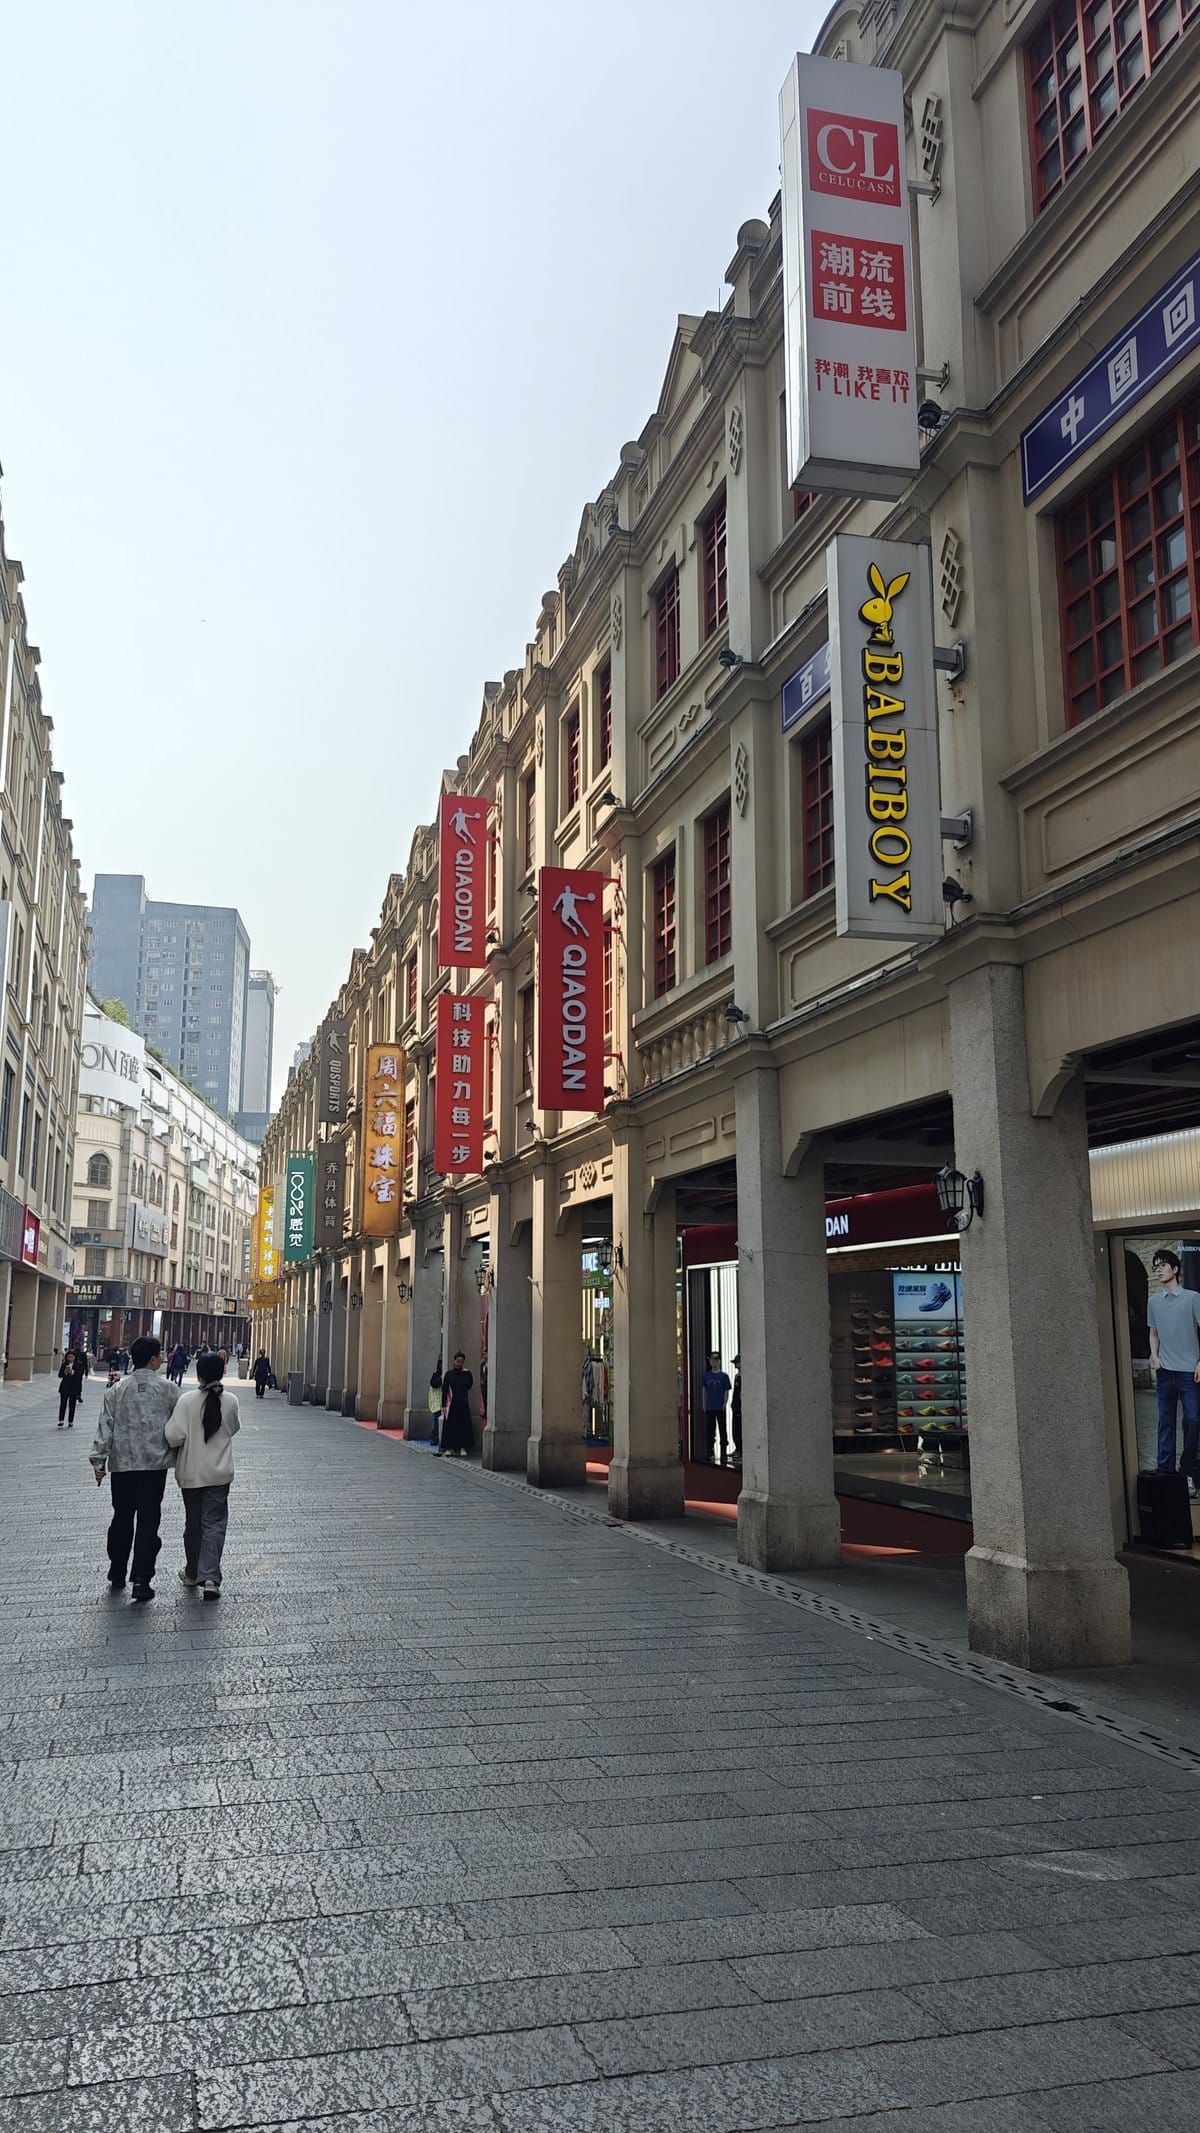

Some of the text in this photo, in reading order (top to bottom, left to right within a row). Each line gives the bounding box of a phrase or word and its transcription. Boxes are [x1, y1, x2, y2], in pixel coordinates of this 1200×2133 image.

[816, 122, 895, 181] CL
[818, 172, 895, 195] CELUCASN
[819, 242, 895, 283] 潮流
[820, 280, 896, 321] 前线
[814, 358, 909, 387] 我潮 我喜欢
[816, 375, 909, 404] I LIKE IT
[861, 648, 913, 914] BABIBOY
[454, 849, 473, 952] QIAODAN
[561, 944, 588, 1091] QIAODAN
[328, 1059, 342, 1113] QDSPORTS
[450, 1001, 472, 1165] 科技助力每一步
[369, 1055, 399, 1203] 周六福珠宝
[323, 1162, 339, 1227] 乔丹体育
[73, 1284, 103, 1294] BALIE
